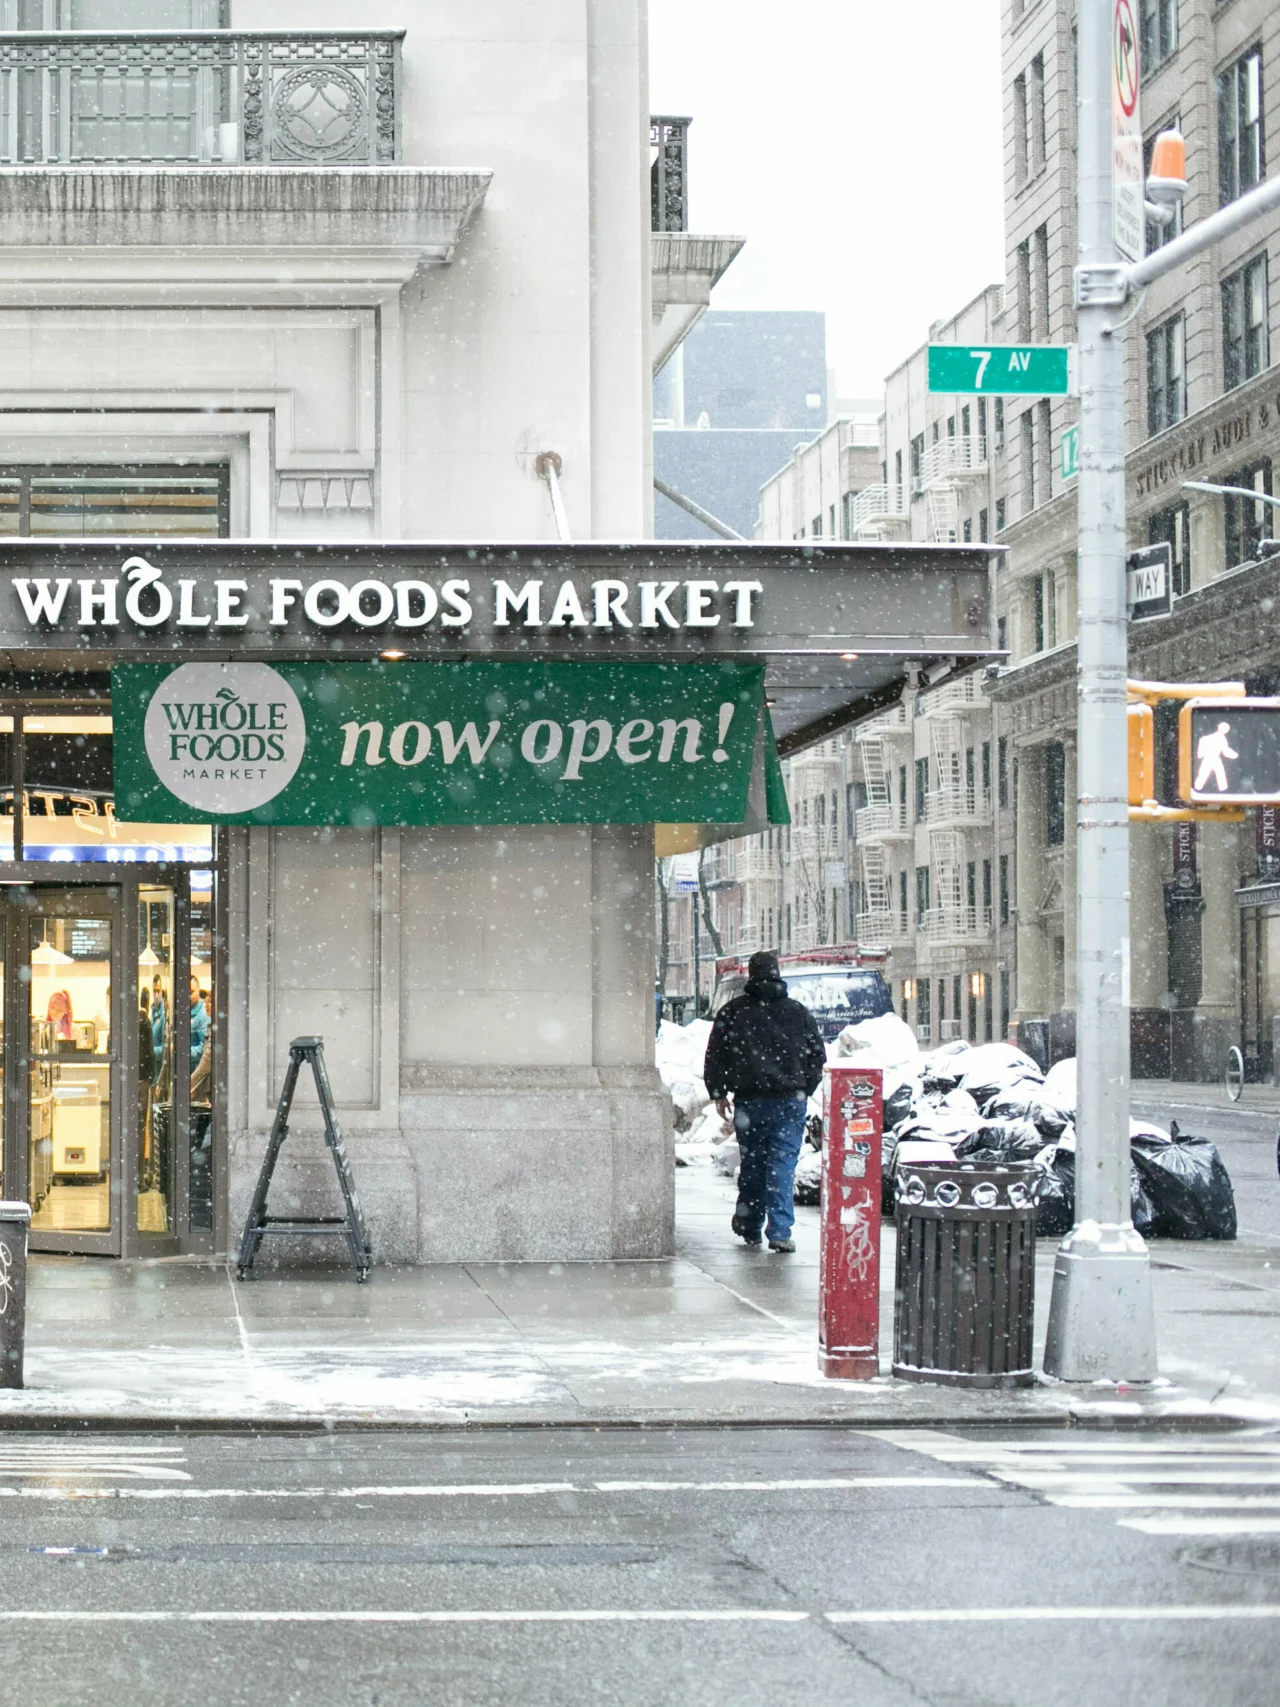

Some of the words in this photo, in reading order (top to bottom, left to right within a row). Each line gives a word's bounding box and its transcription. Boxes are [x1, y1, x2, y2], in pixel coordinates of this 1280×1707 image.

[969, 351, 992, 389] 7
[1007, 351, 1031, 371] AV
[1136, 436, 1204, 498] STICKLEY
[1212, 411, 1250, 455] AUDI
[1259, 404, 1269, 430] &
[12, 557, 249, 626] WHOLE
[269, 579, 472, 627] FOODS
[492, 579, 763, 628] MARKET
[1136, 567, 1160, 599] WAY
[161, 687, 288, 731] WHOLE
[168, 734, 286, 762] FOODS
[340, 719, 501, 766] now
[520, 702, 736, 780] open!
[183, 768, 267, 780] MARKET
[1263, 804, 1275, 847] STICK
